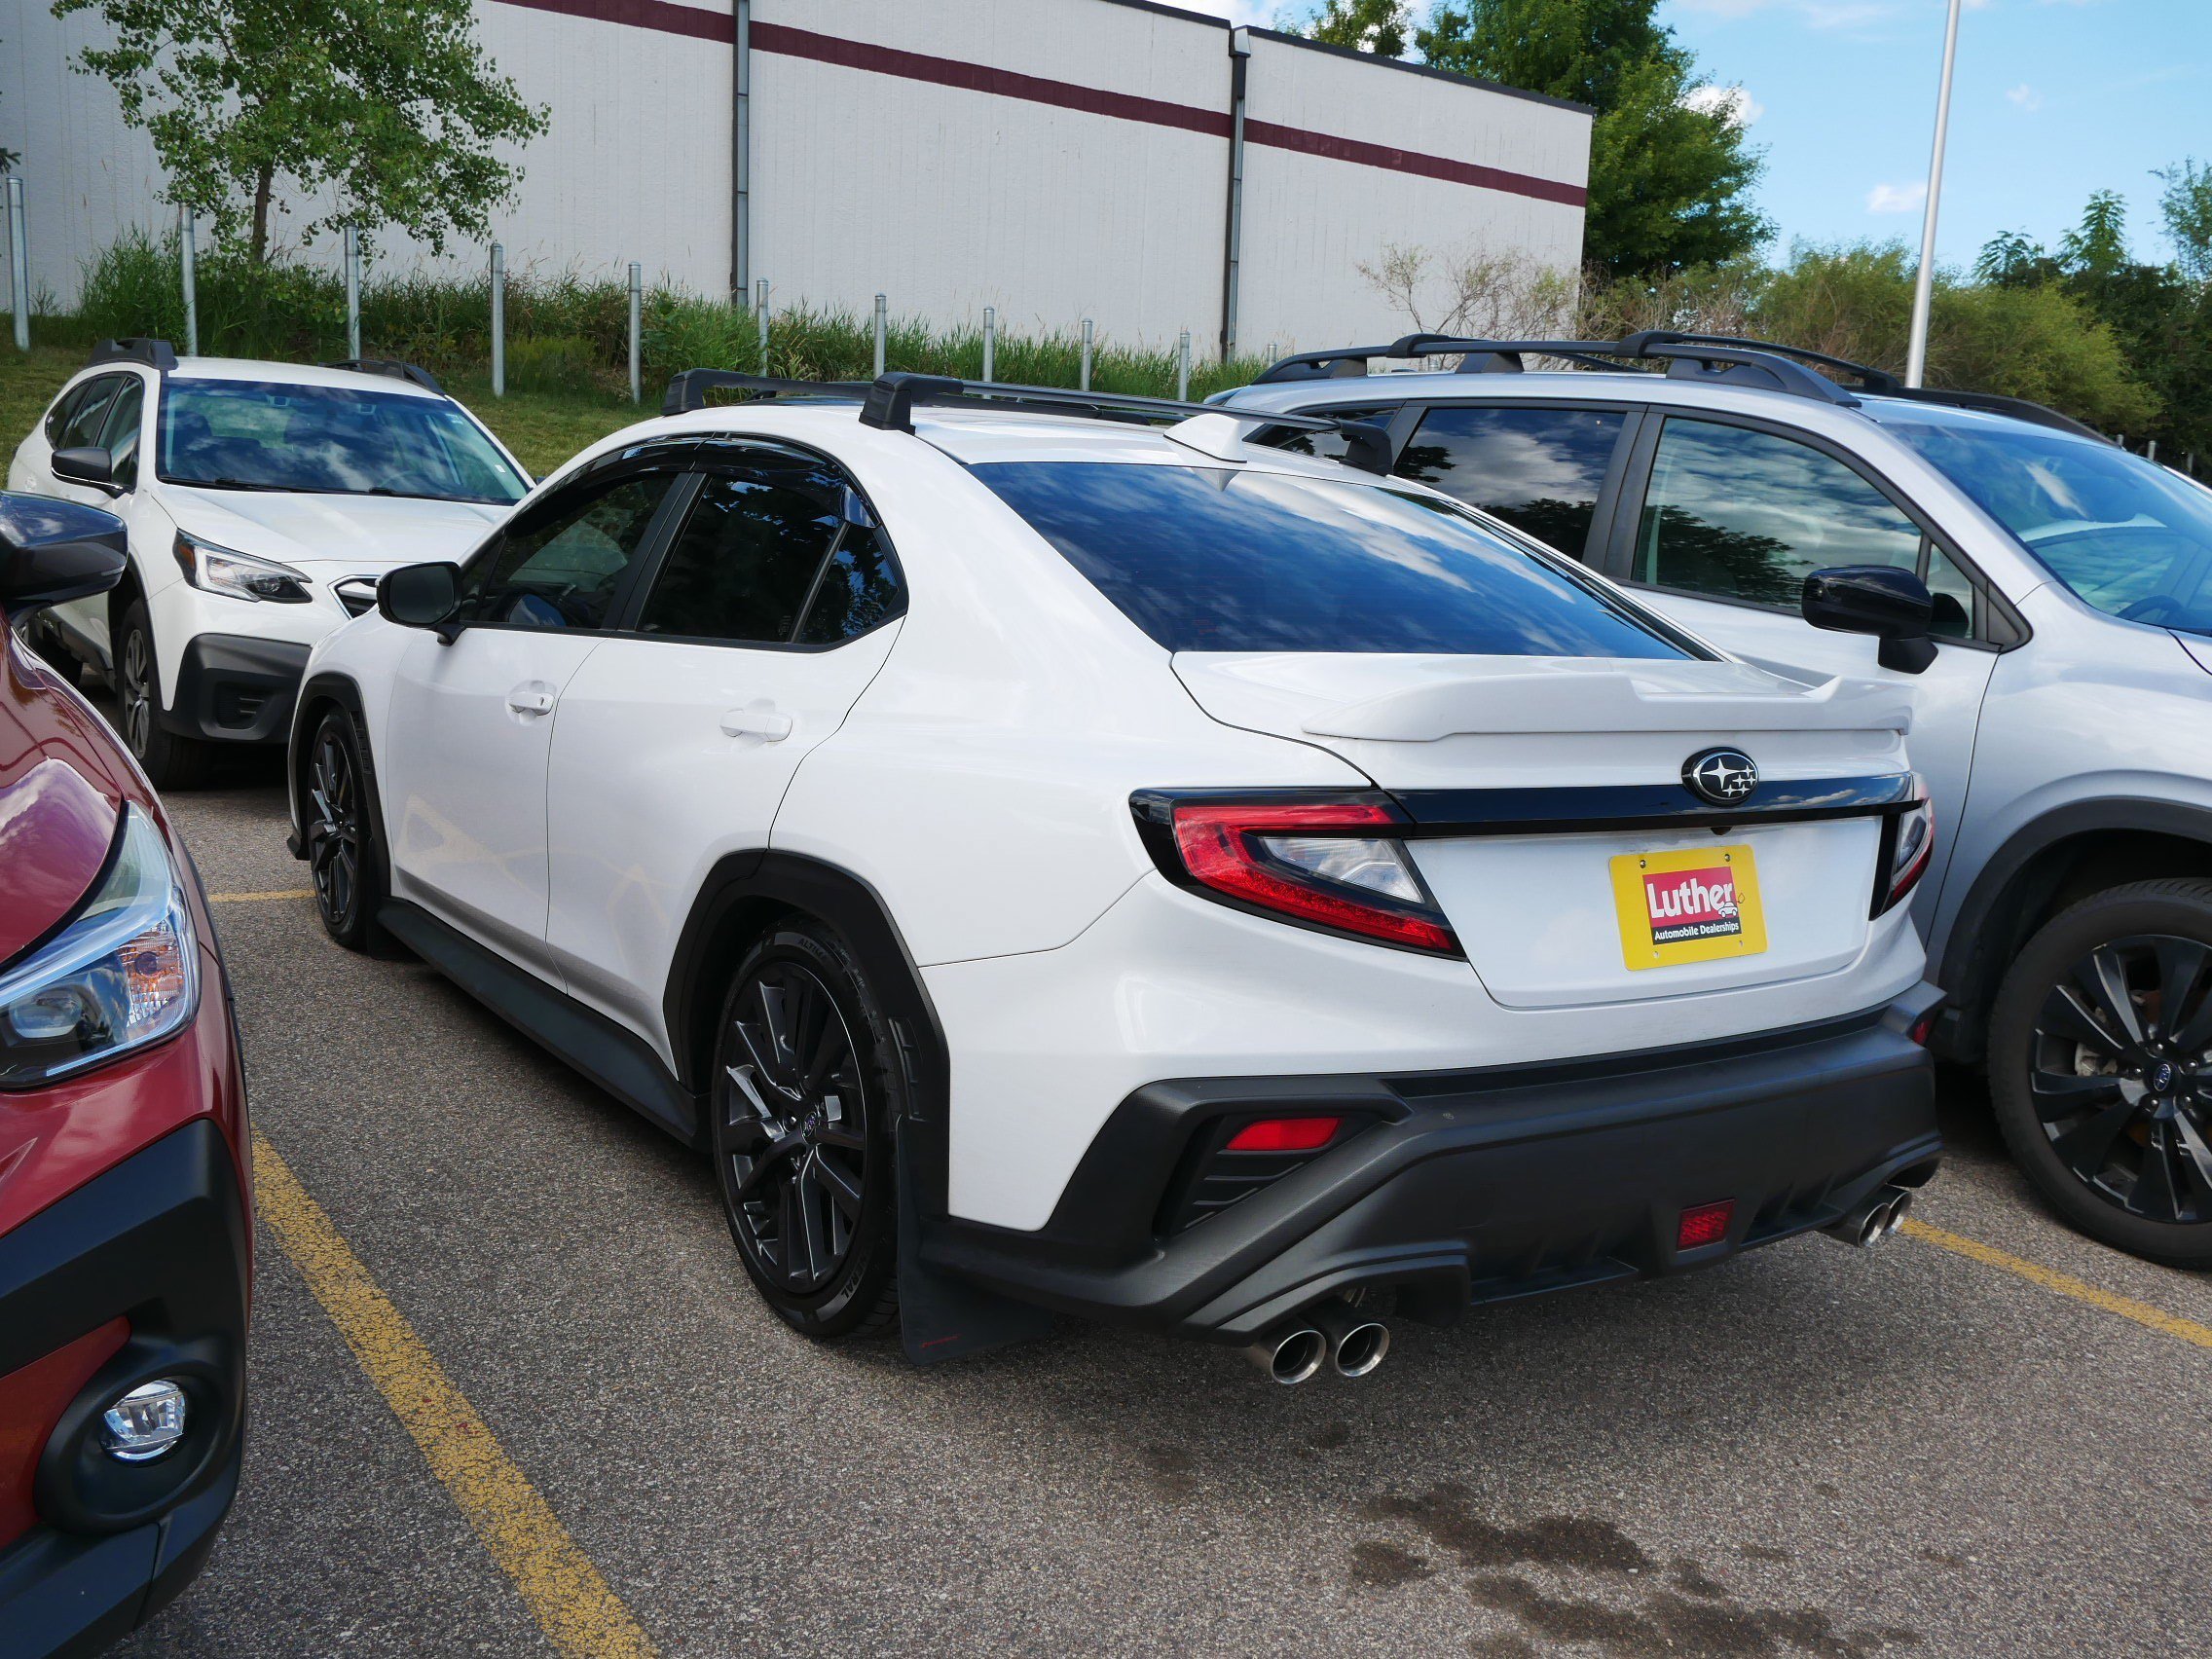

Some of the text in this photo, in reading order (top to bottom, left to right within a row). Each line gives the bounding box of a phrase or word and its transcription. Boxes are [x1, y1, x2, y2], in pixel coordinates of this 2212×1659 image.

[1646, 877, 1733, 918] Luther
[1654, 921, 1739, 940] Automobile Dealerships
